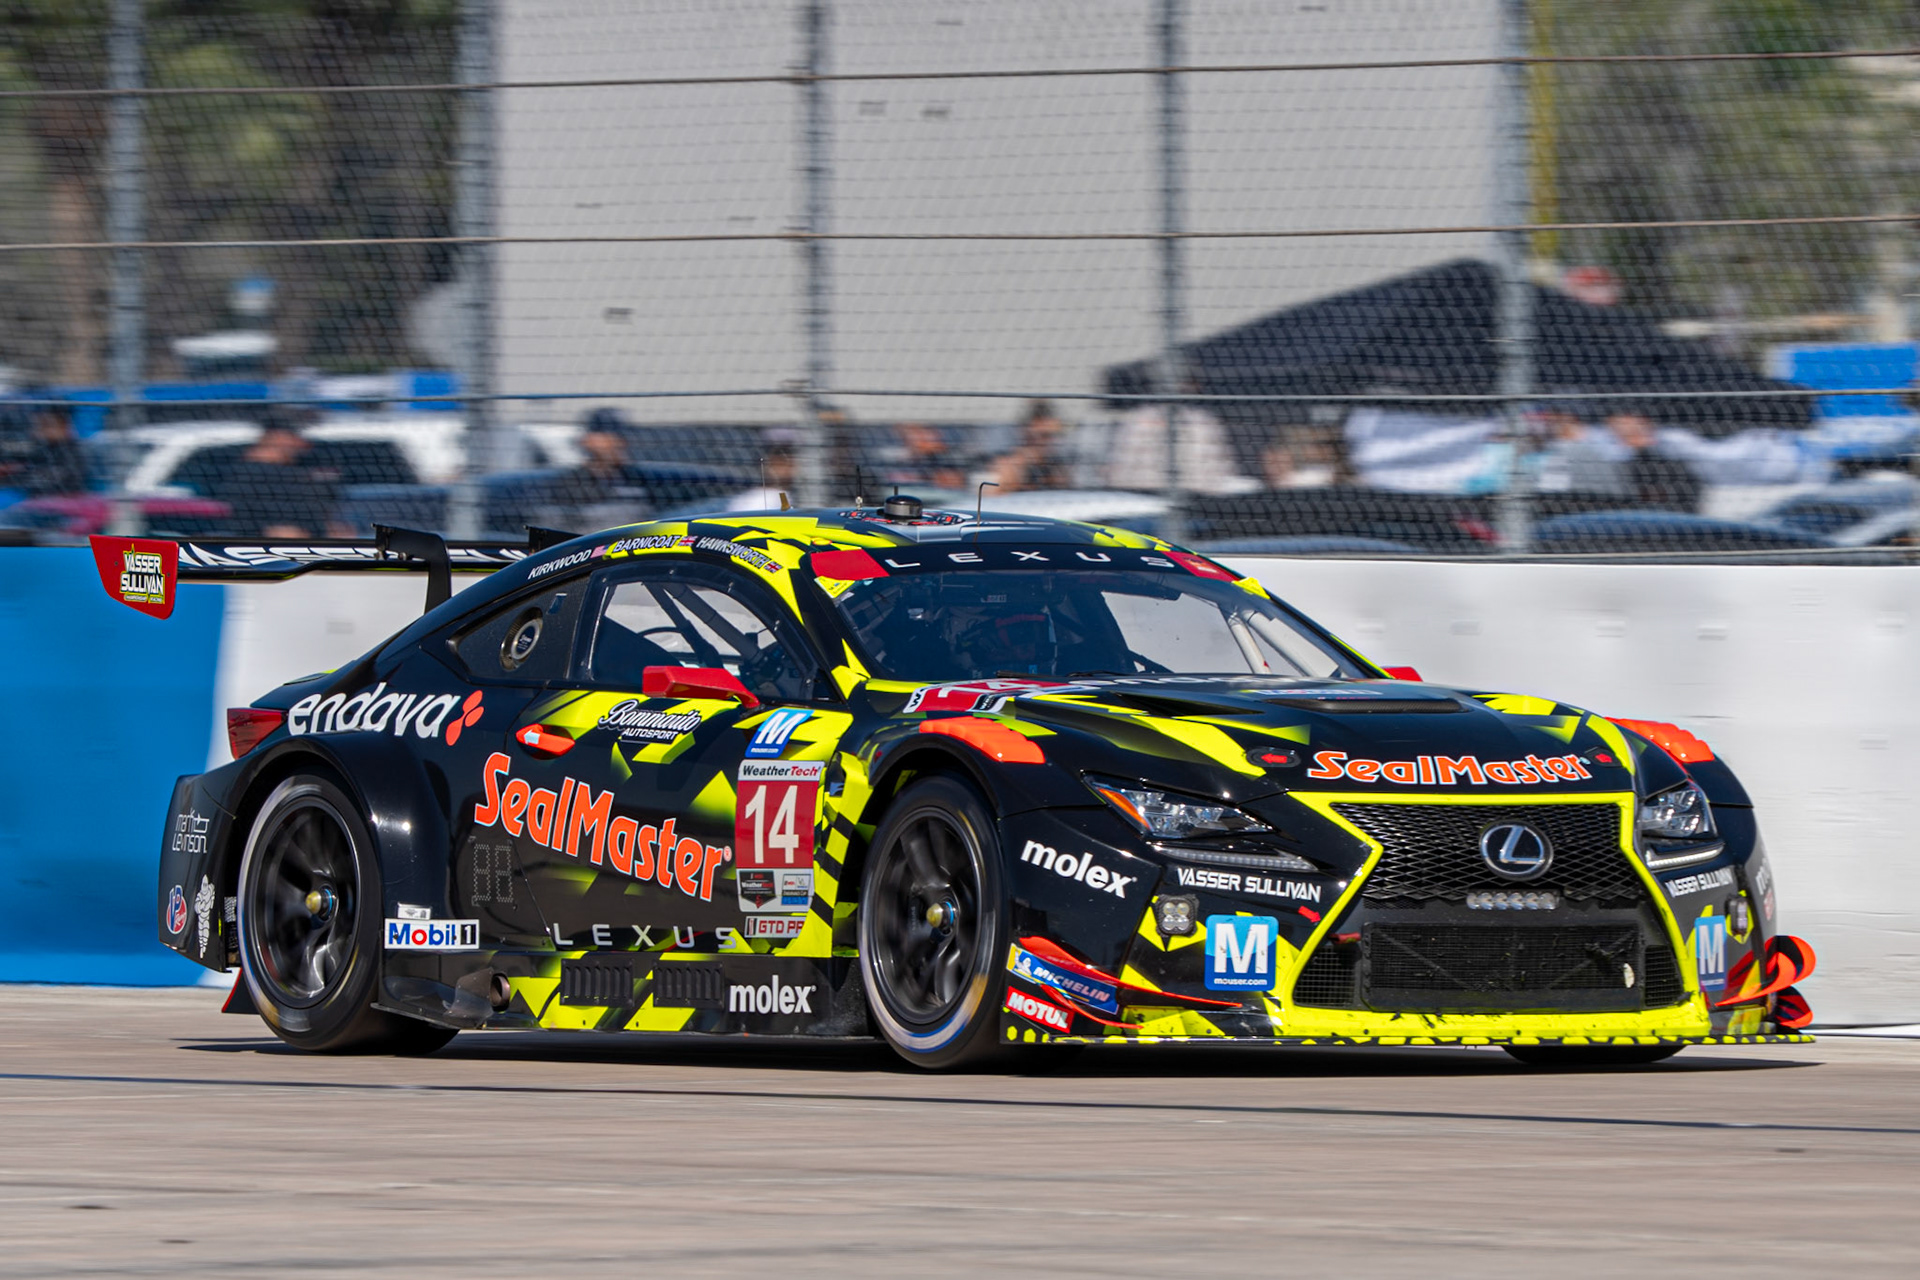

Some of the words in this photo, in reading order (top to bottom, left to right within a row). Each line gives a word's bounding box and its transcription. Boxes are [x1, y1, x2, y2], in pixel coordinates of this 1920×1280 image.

[612, 536, 681, 552] BARNICOAT
[696, 537, 771, 569] HAWKSWORTH
[885, 551, 1175, 569] LEXUS
[124, 553, 160, 574] VASSER
[527, 549, 592, 580] KIRKWOOD
[121, 574, 164, 595] SULLIVAN
[288, 682, 460, 738] endava
[621, 729, 679, 740] AUTOSPORT
[755, 712, 807, 744] M
[743, 765, 818, 776] WeatherTech
[1307, 751, 1591, 785] SealMaster
[474, 752, 721, 902] SealMaster
[744, 785, 799, 864] 14
[1021, 840, 1134, 898] molex
[1178, 868, 1241, 892] VASSER
[1244, 879, 1321, 902] SULLIVAN
[389, 923, 455, 945] Mobil
[553, 923, 737, 949] LEXUS
[758, 920, 784, 934] GTD
[1214, 923, 1268, 973] M
[1699, 924, 1725, 975] M
[729, 974, 813, 1013] molex
[1033, 967, 1110, 1002] MICHELIN
[1007, 992, 1068, 1029] MOTUL
